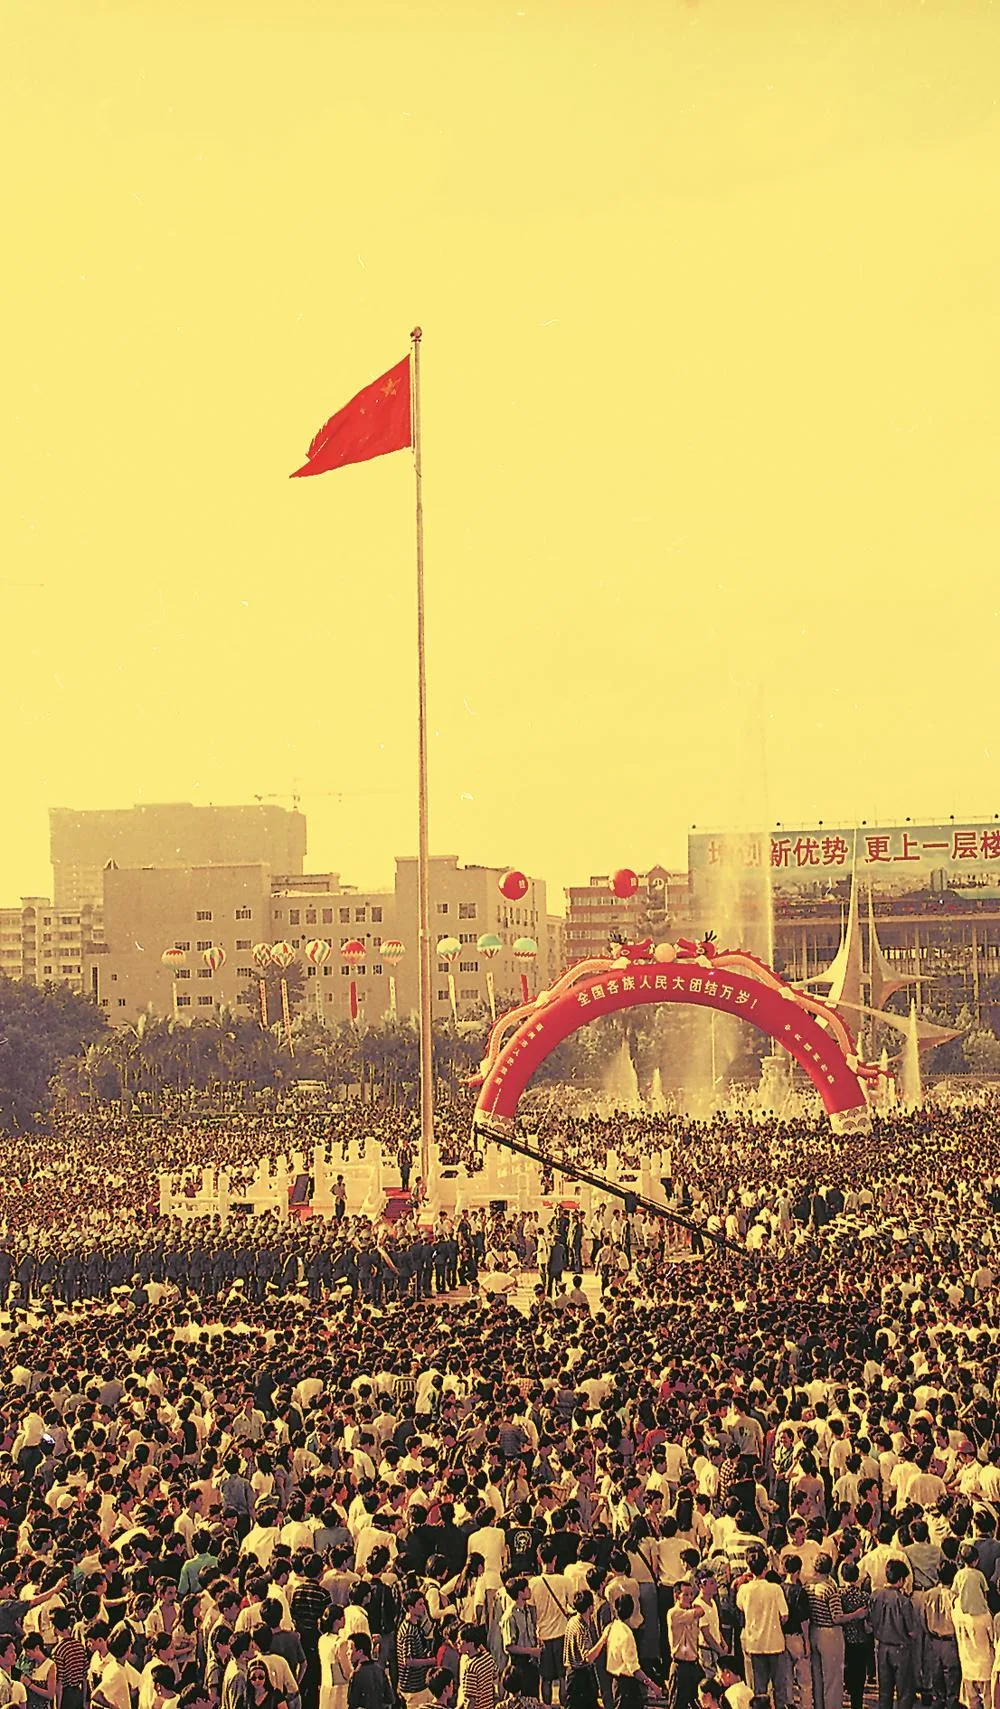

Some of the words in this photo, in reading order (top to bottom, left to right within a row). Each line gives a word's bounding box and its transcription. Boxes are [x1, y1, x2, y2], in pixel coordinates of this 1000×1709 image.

[864, 830, 1000, 863] 更上一层楼
